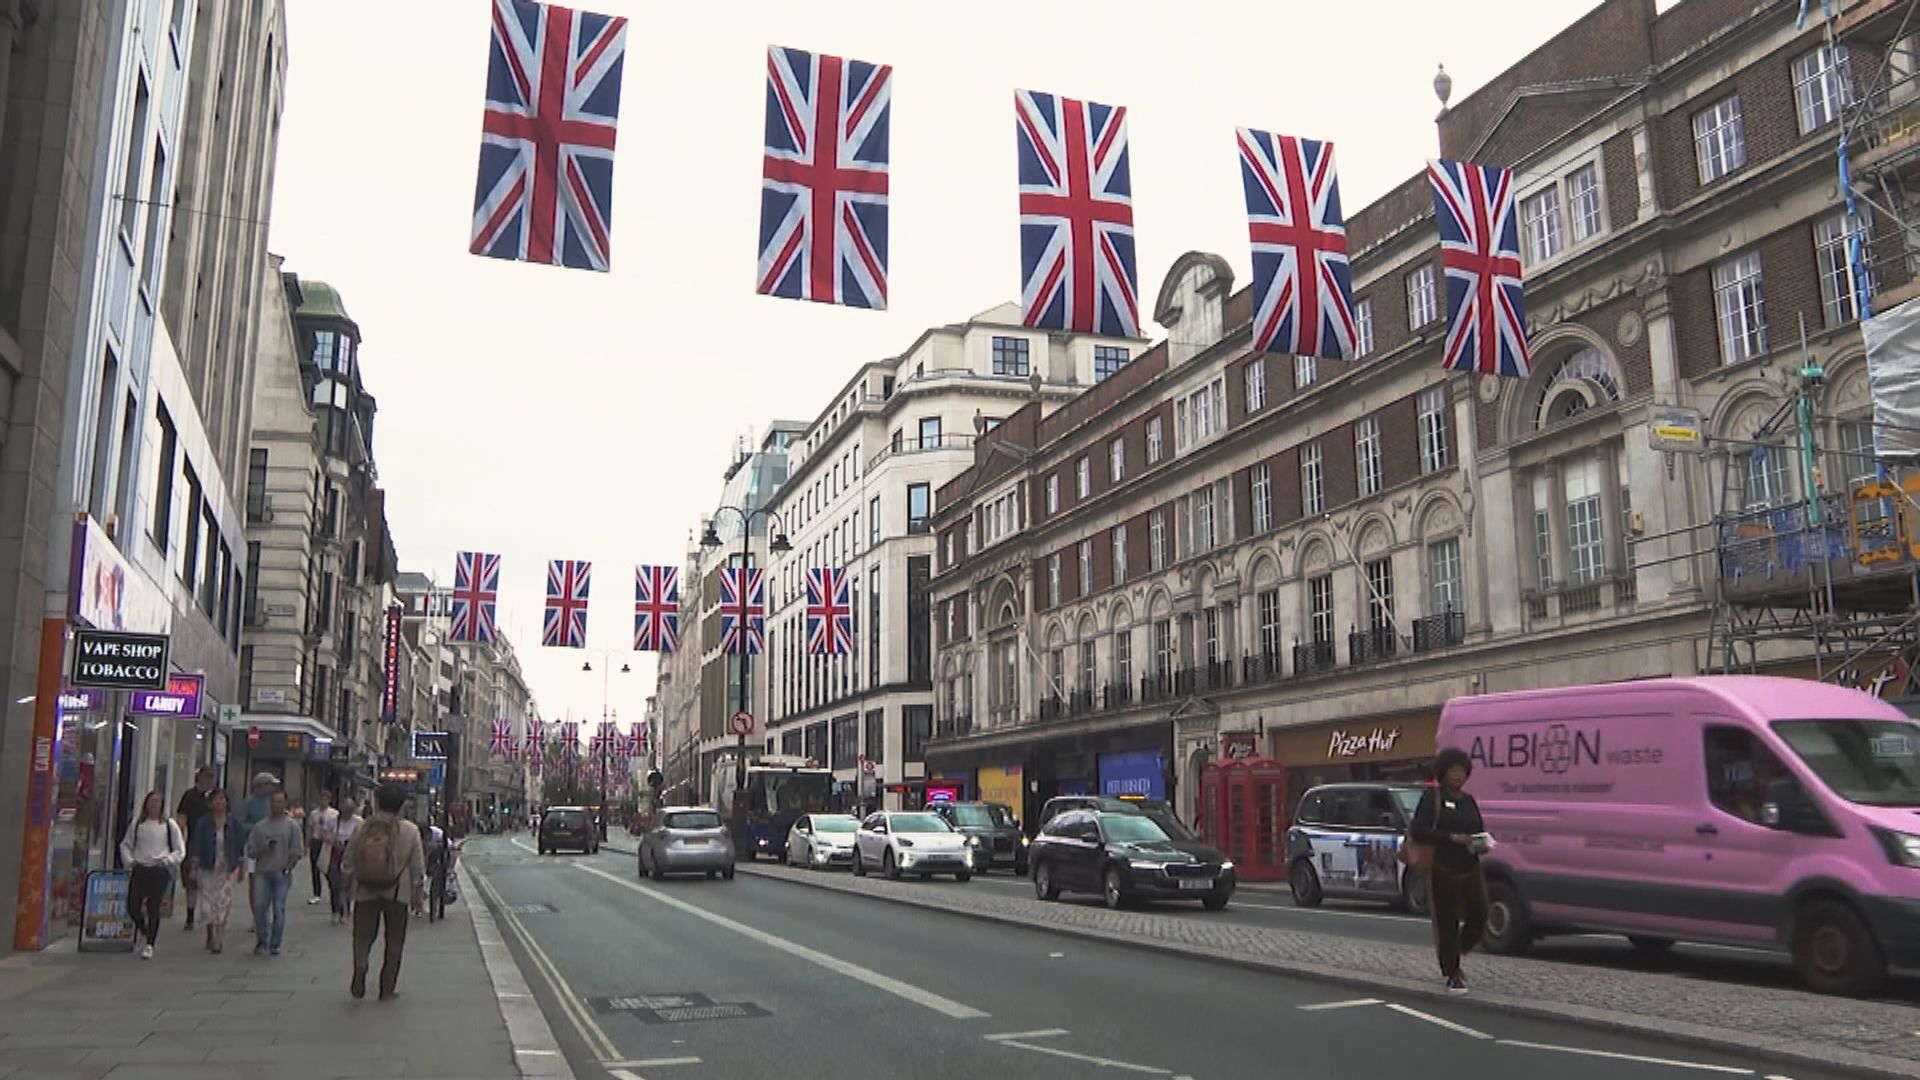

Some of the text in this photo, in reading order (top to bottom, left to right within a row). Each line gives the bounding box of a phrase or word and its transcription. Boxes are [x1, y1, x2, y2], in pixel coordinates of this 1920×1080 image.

[83, 641, 162, 659] VAPE SHOP
[80, 662, 160, 680] TOBACCO
[144, 695, 187, 713] CANDY
[1327, 727, 1397, 758] Pizza Hut
[1605, 747, 1664, 765] waste
